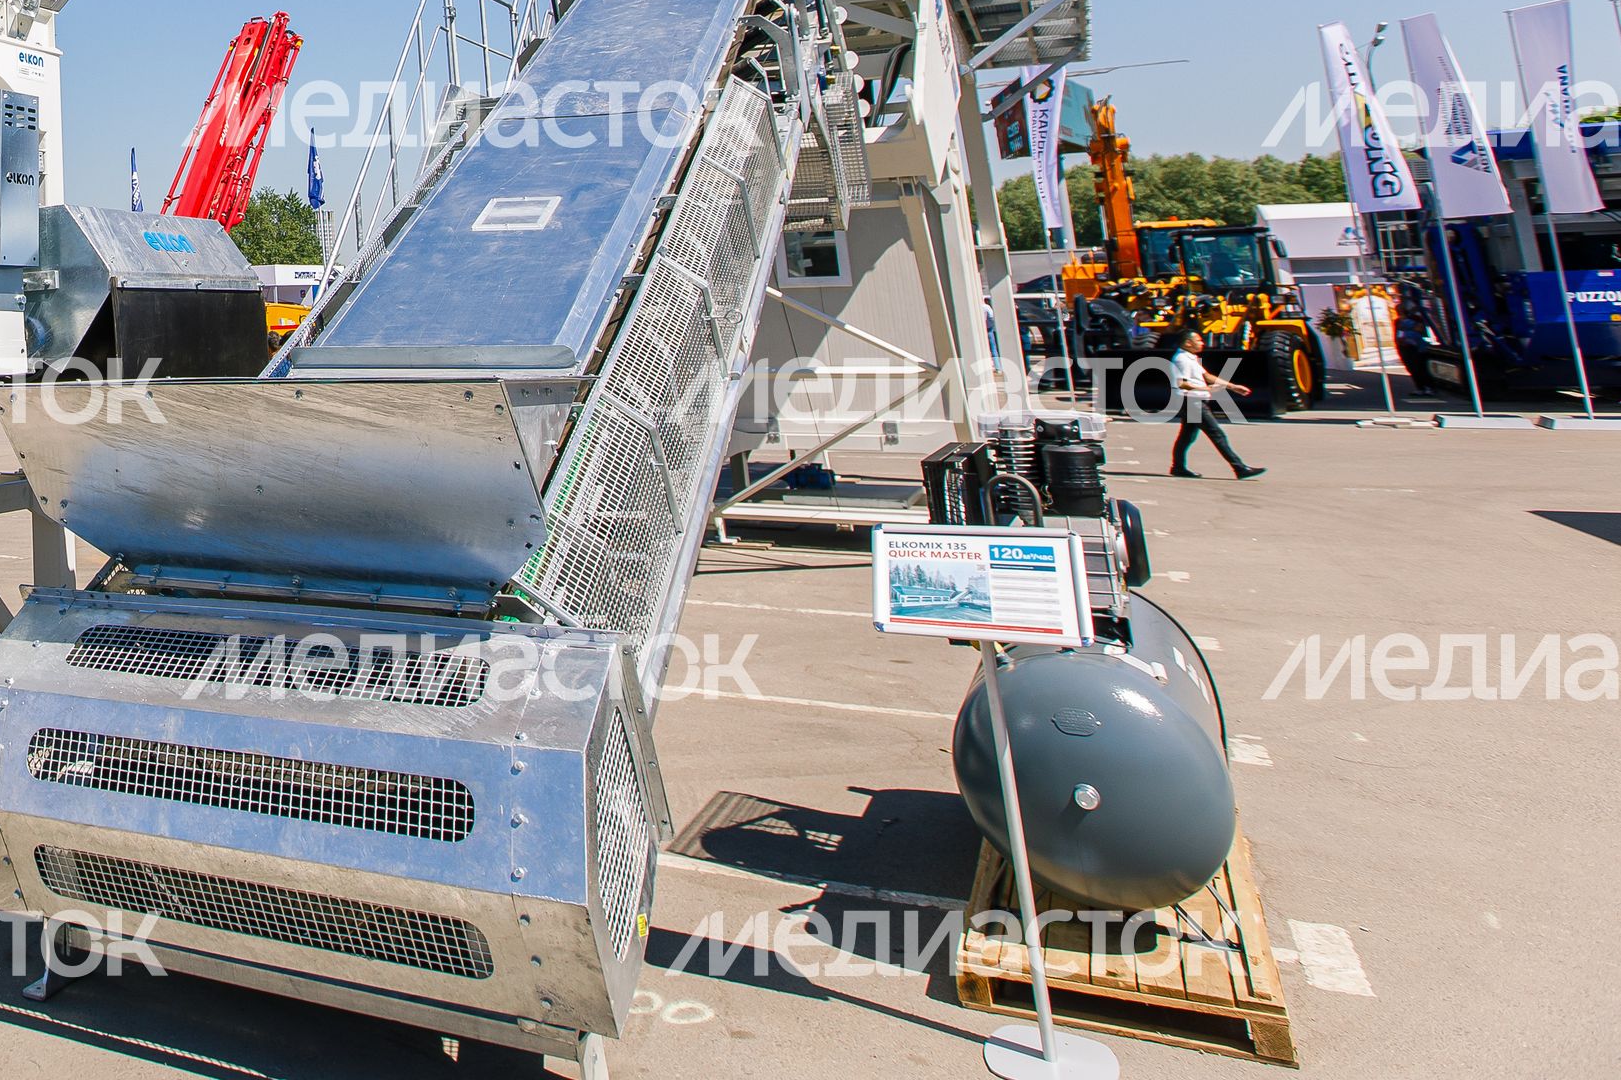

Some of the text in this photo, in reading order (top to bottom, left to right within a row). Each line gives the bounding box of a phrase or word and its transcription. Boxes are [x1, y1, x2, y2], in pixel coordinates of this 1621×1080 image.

[19, 52, 44, 67] elkon
[6, 172, 35, 186] elkon
[142, 231, 196, 254] elkon
[888, 540, 967, 551] ELKOMIX 135
[888, 550, 982, 560] QUICK MASTER
